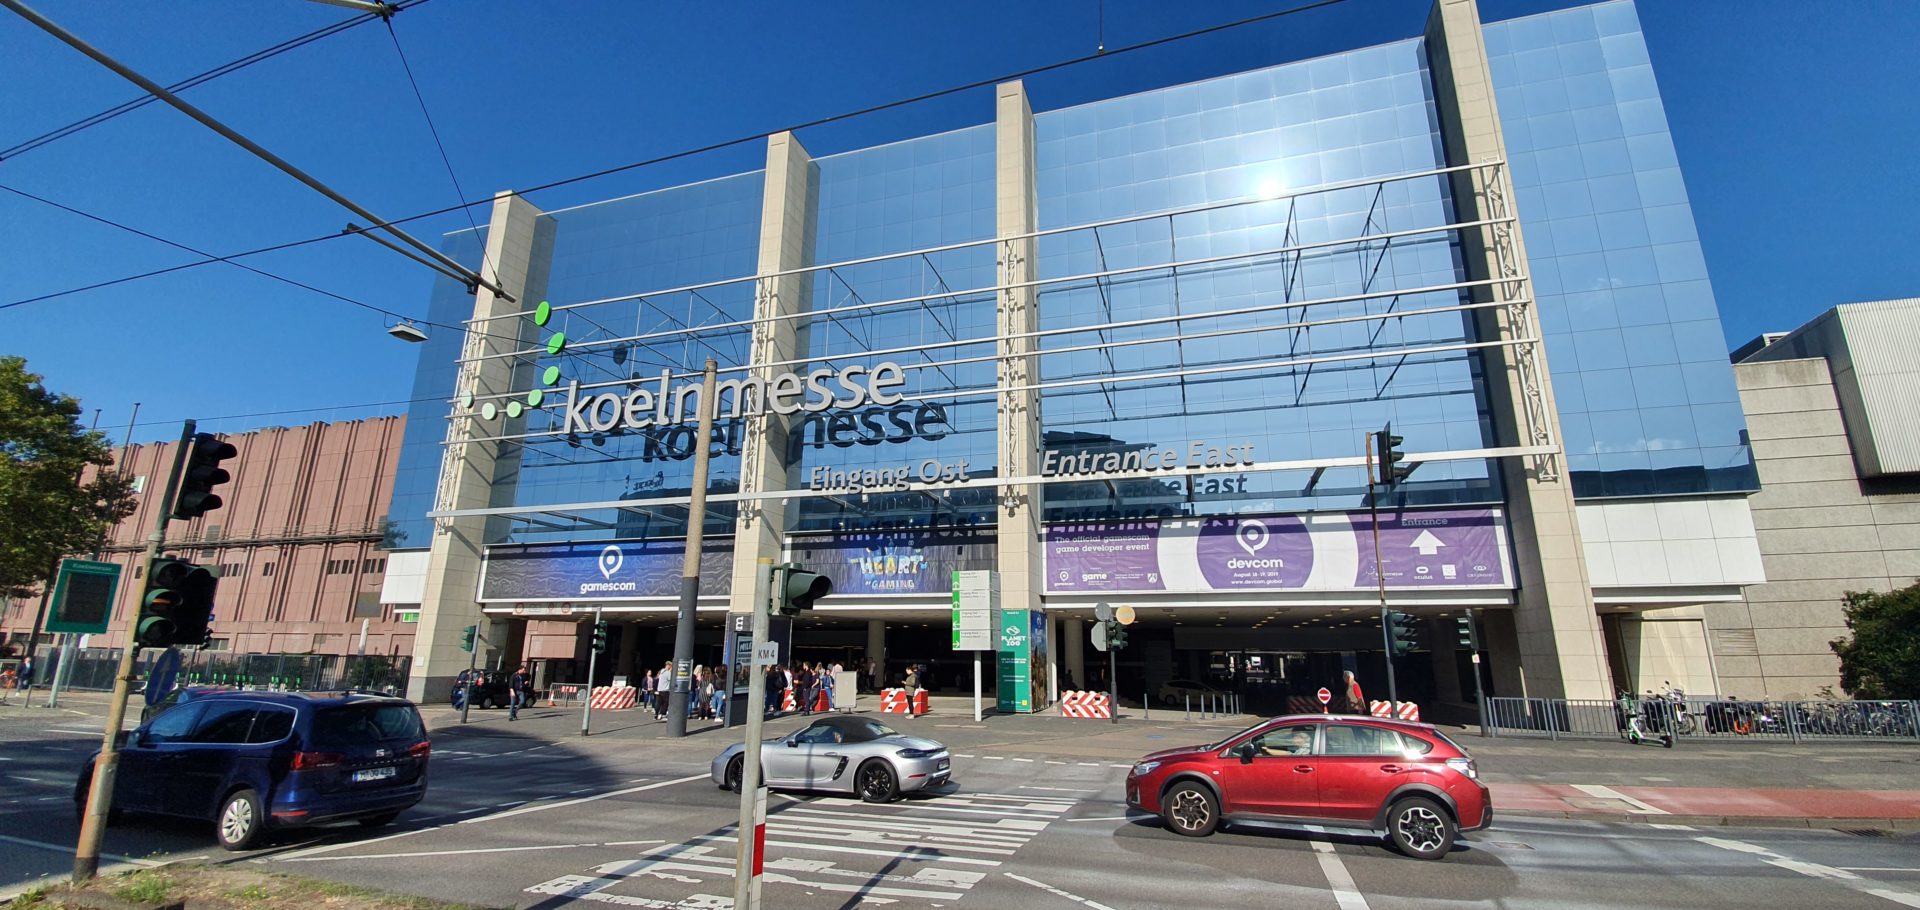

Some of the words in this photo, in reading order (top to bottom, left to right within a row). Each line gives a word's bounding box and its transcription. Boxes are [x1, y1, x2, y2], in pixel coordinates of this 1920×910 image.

[563, 361, 906, 435] koelnmesse
[1042, 444, 1178, 476] Entrance
[1186, 439, 1256, 468] East
[809, 464, 911, 494] Eingang
[918, 456, 971, 484] Ost
[1401, 518, 1449, 527] Entrance
[1054, 536, 1070, 544] The
[1072, 535, 1101, 543] official
[1103, 534, 1150, 543] gamescom
[1055, 546, 1080, 554] game
[1081, 544, 1123, 553] developer
[1125, 543, 1150, 551] event
[859, 554, 925, 576] HEART
[1227, 557, 1284, 569] devcom
[1081, 573, 1108, 582] game
[580, 582, 636, 595] gamescom
[871, 579, 915, 590] GAMING
[757, 649, 769, 660] KM
[770, 649, 775, 658] 4
